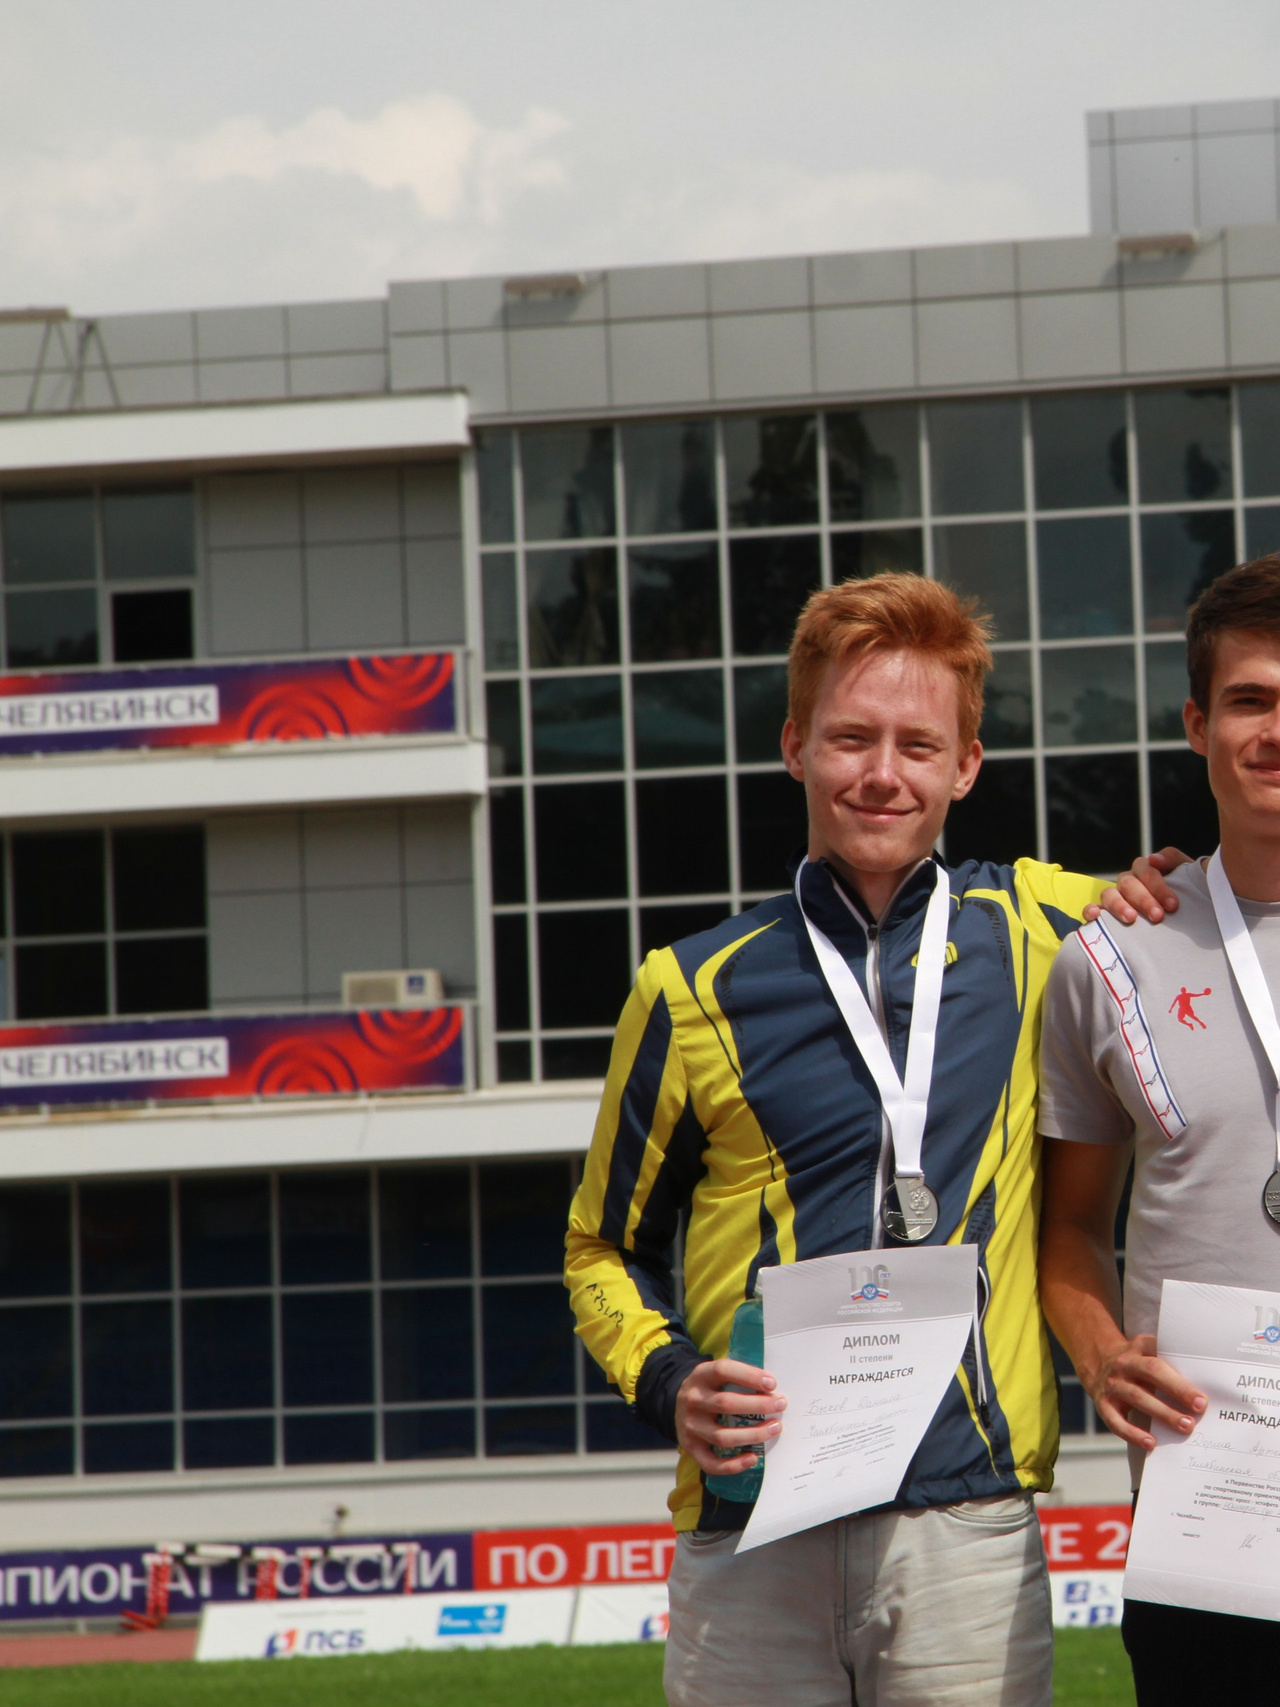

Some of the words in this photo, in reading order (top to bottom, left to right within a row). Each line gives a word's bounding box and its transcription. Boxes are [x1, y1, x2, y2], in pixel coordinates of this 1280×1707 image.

[0, 692, 212, 727] ЧЕЛЯБИНСК
[3, 1045, 221, 1078] ЧЕЛЯБИНСК
[842, 1334, 901, 1350] ДИПЛОМ
[858, 1354, 893, 1364] степени
[829, 1367, 914, 1385] НАГРАЖДАЕТСЯ
[1212, 1486, 1253, 1498] спортивному
[1230, 1479, 1265, 1491] Первенстве
[1198, 1500, 1221, 1509] группе:
[1041, 1521, 1084, 1562] Е
[1095, 1520, 1130, 1561] 2
[489, 1543, 568, 1586] ПО
[0, 1557, 213, 1605] ПИОНАТ
[237, 1549, 457, 1597] РОССИИ
[304, 1628, 366, 1652] ПСБ
